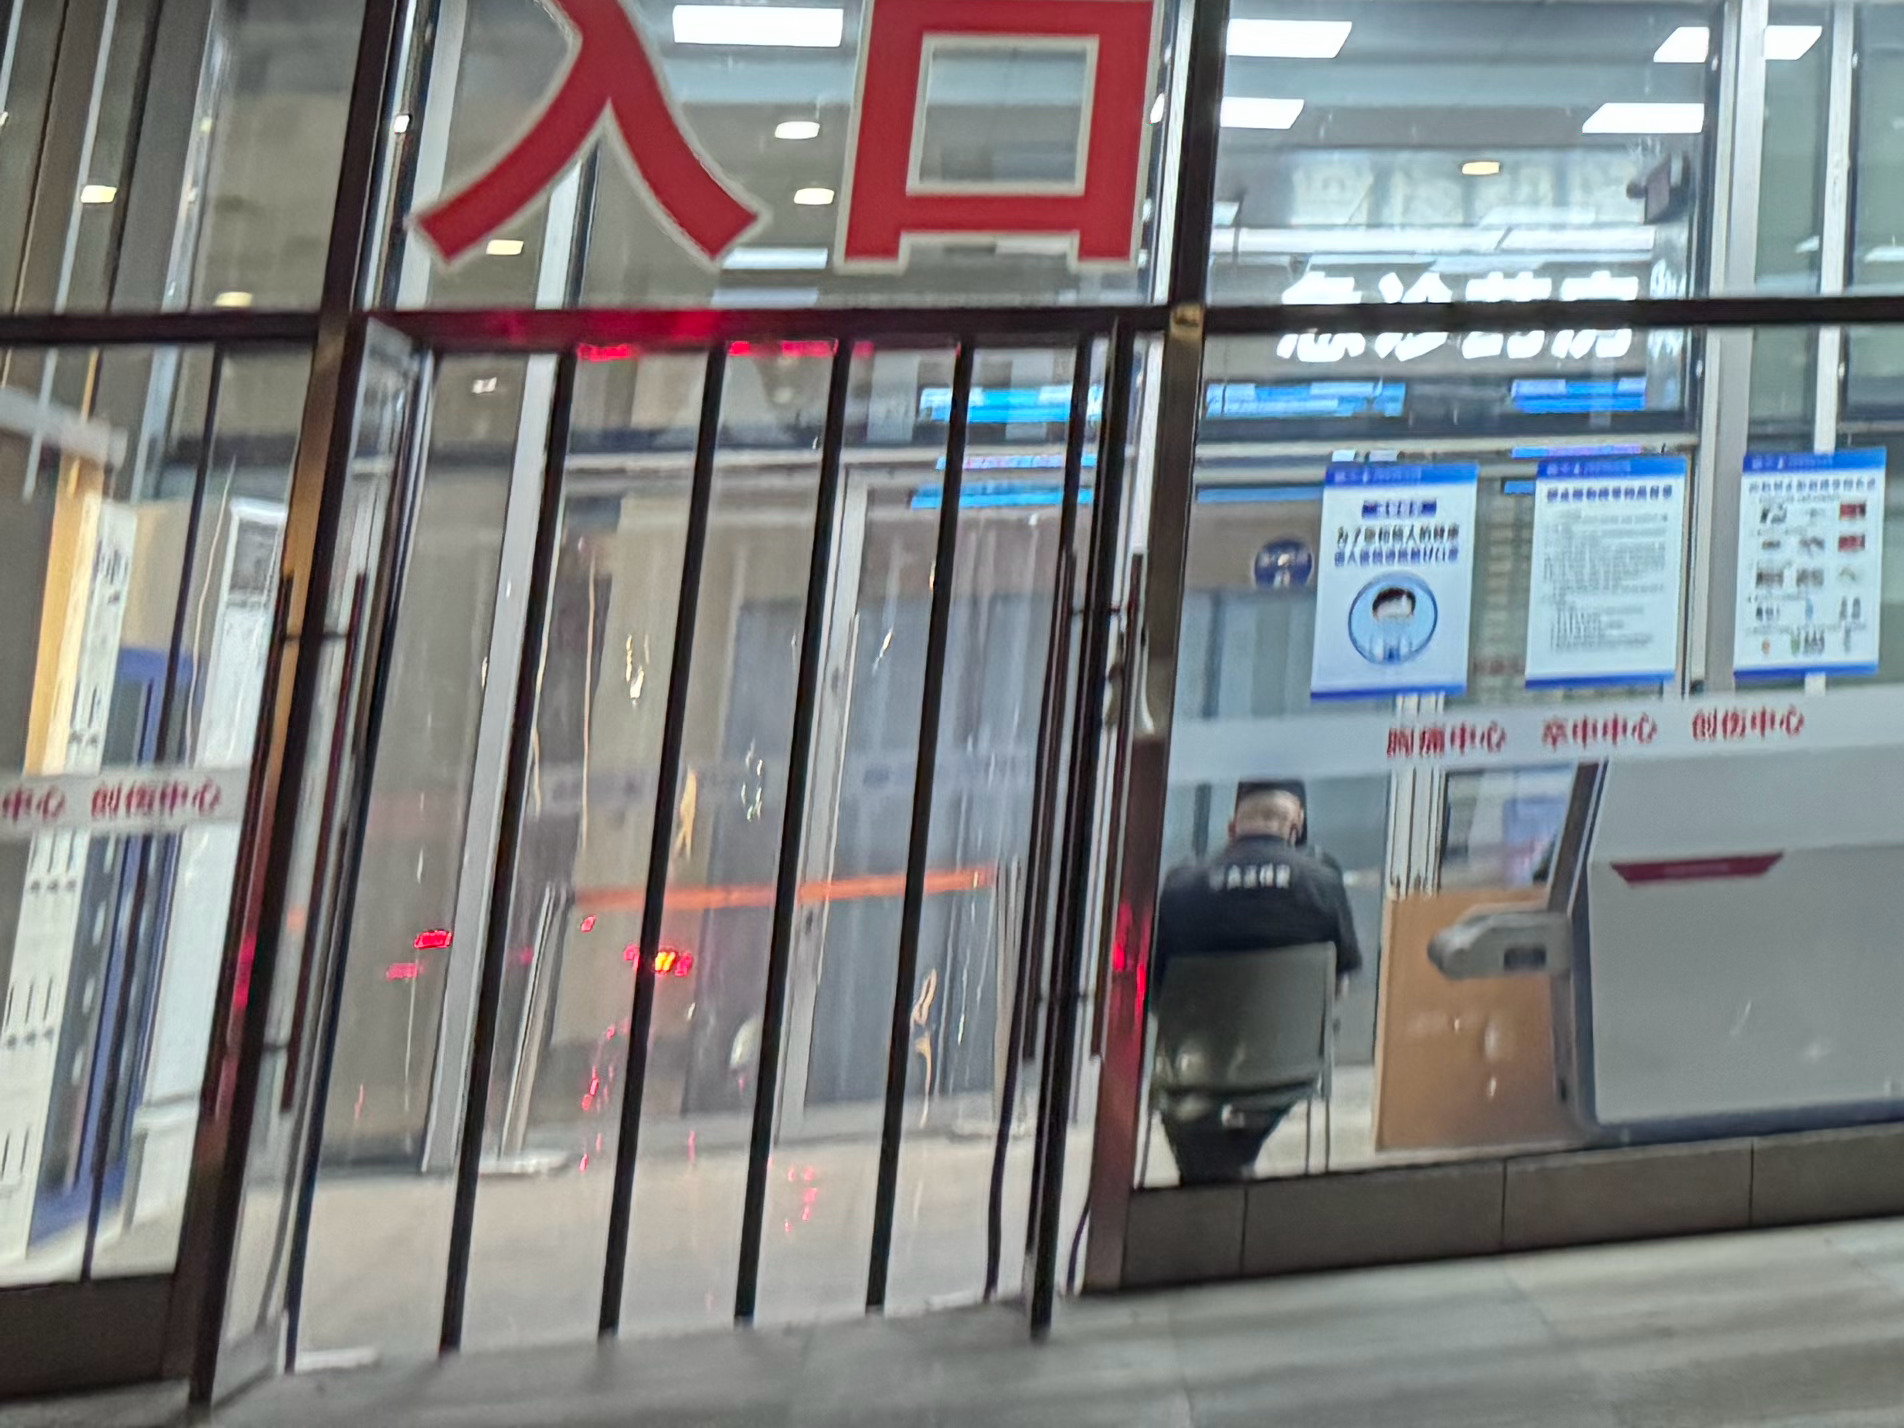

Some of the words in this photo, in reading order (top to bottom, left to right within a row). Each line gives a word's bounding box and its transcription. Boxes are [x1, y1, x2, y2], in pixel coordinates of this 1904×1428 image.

[1386, 718, 1507, 761] 胸痛中心
[1542, 711, 1658, 752] 卒中中心
[1691, 704, 1806, 743] 创伤中心
[91, 776, 222, 819] 创伤中心
